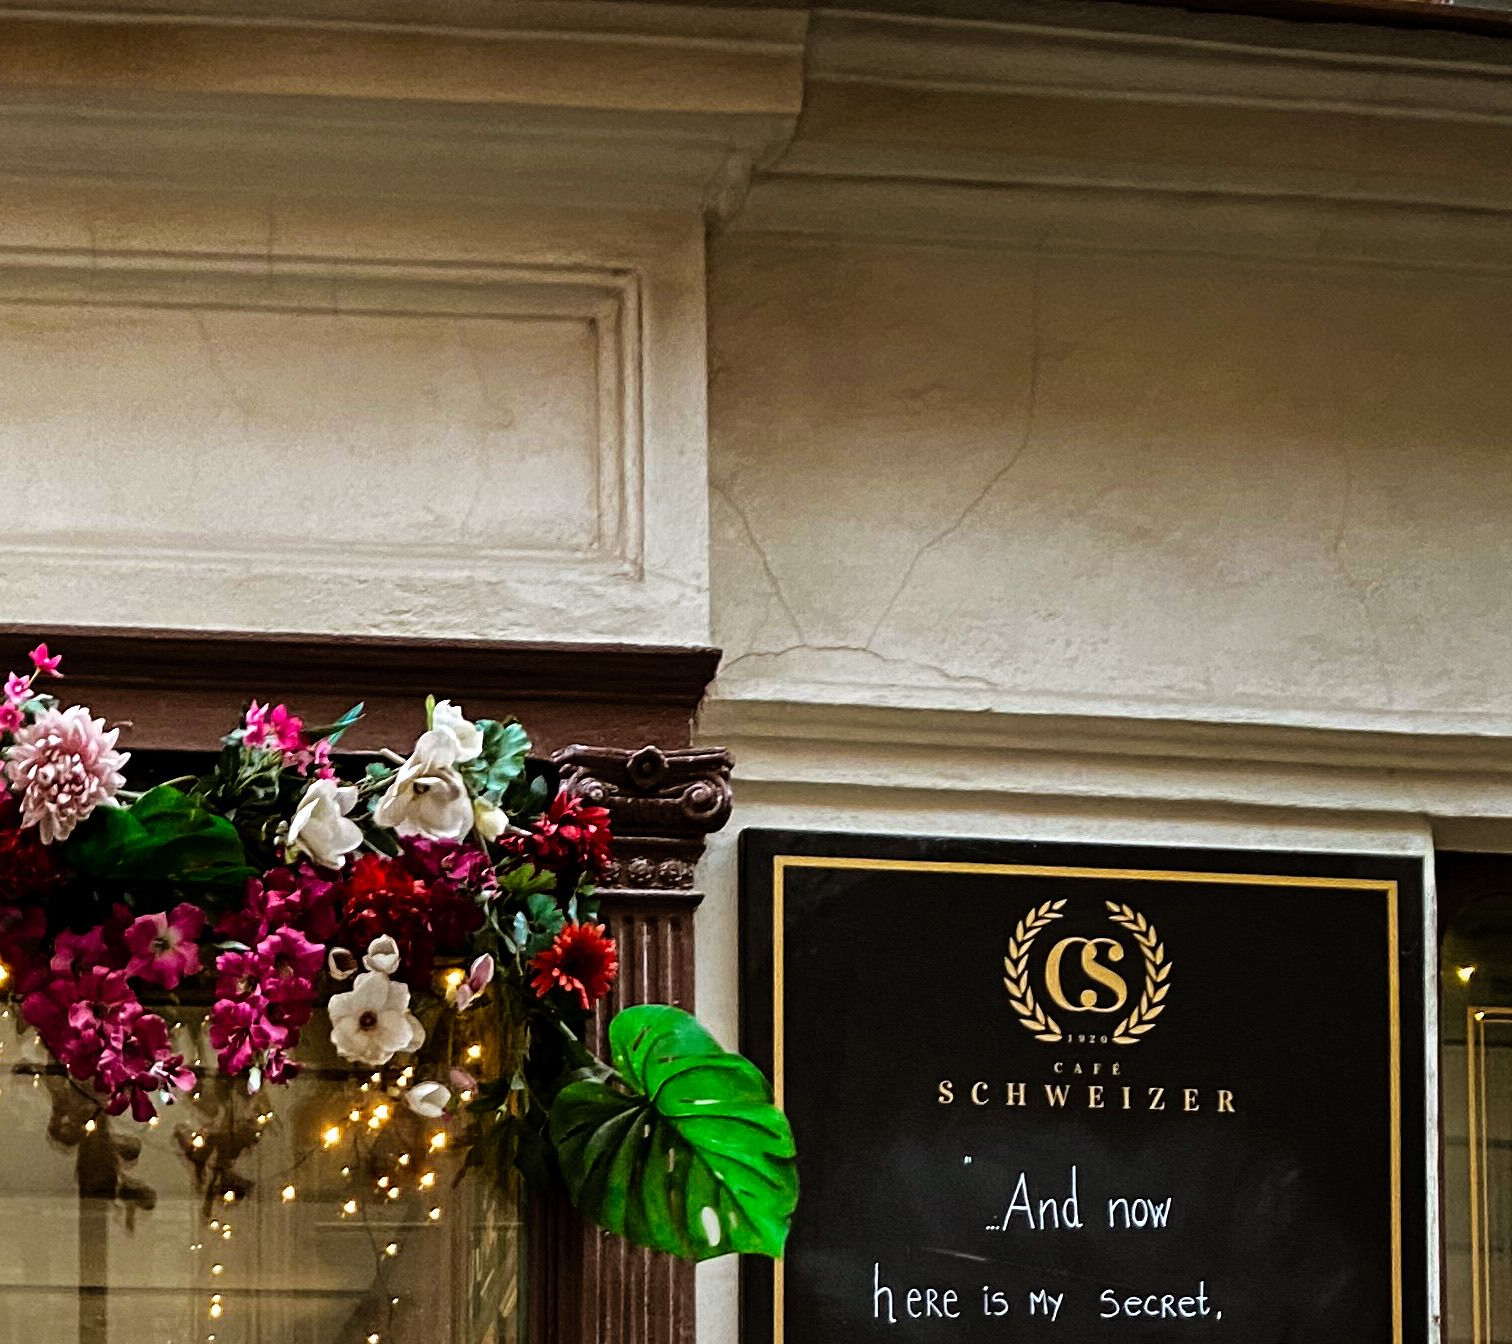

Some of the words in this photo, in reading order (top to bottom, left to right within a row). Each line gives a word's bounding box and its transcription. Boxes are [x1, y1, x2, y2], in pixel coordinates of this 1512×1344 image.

[1044, 936, 1128, 1013] CS
[1053, 1061, 1120, 1076] CAFÉ
[938, 1080, 1236, 1113] SCHWEIZER
[1108, 1197, 1172, 1229] now
[982, 1285, 1009, 1316] is
